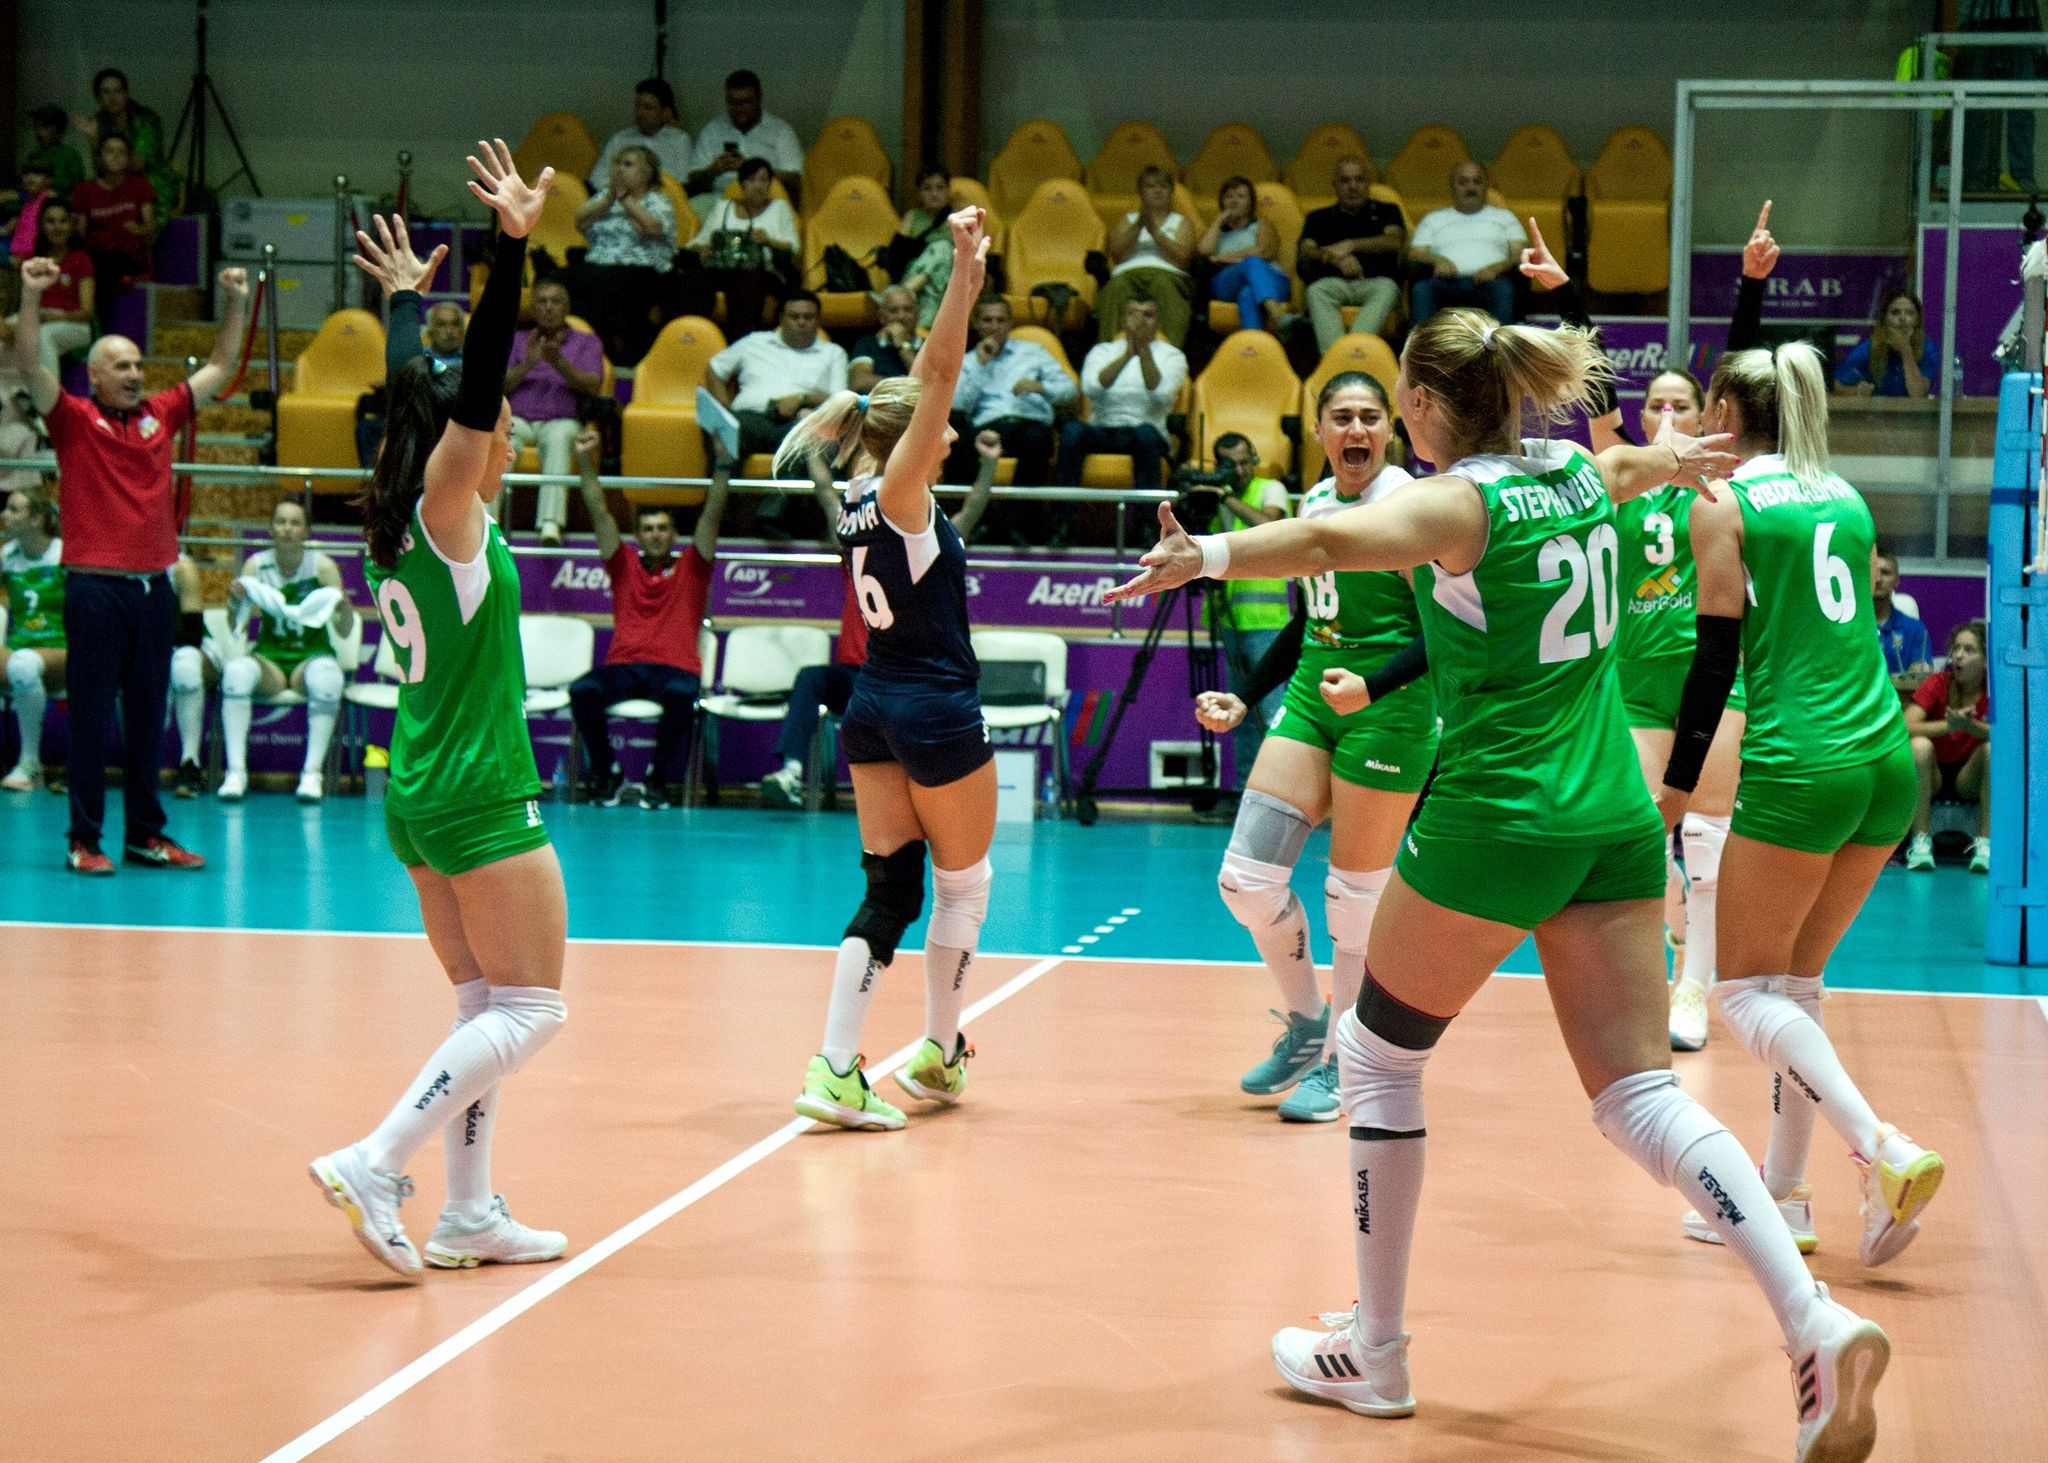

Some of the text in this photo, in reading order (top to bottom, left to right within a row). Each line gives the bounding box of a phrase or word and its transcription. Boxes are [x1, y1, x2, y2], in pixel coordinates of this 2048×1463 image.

[1644, 512, 1675, 566] 3
[732, 567, 770, 583] ADY
[852, 546, 895, 630] 6
[1302, 570, 1340, 620] 18
[1538, 523, 1620, 665] 20
[1813, 522, 1856, 624] 6
[1628, 592, 1693, 615] AzerGold
